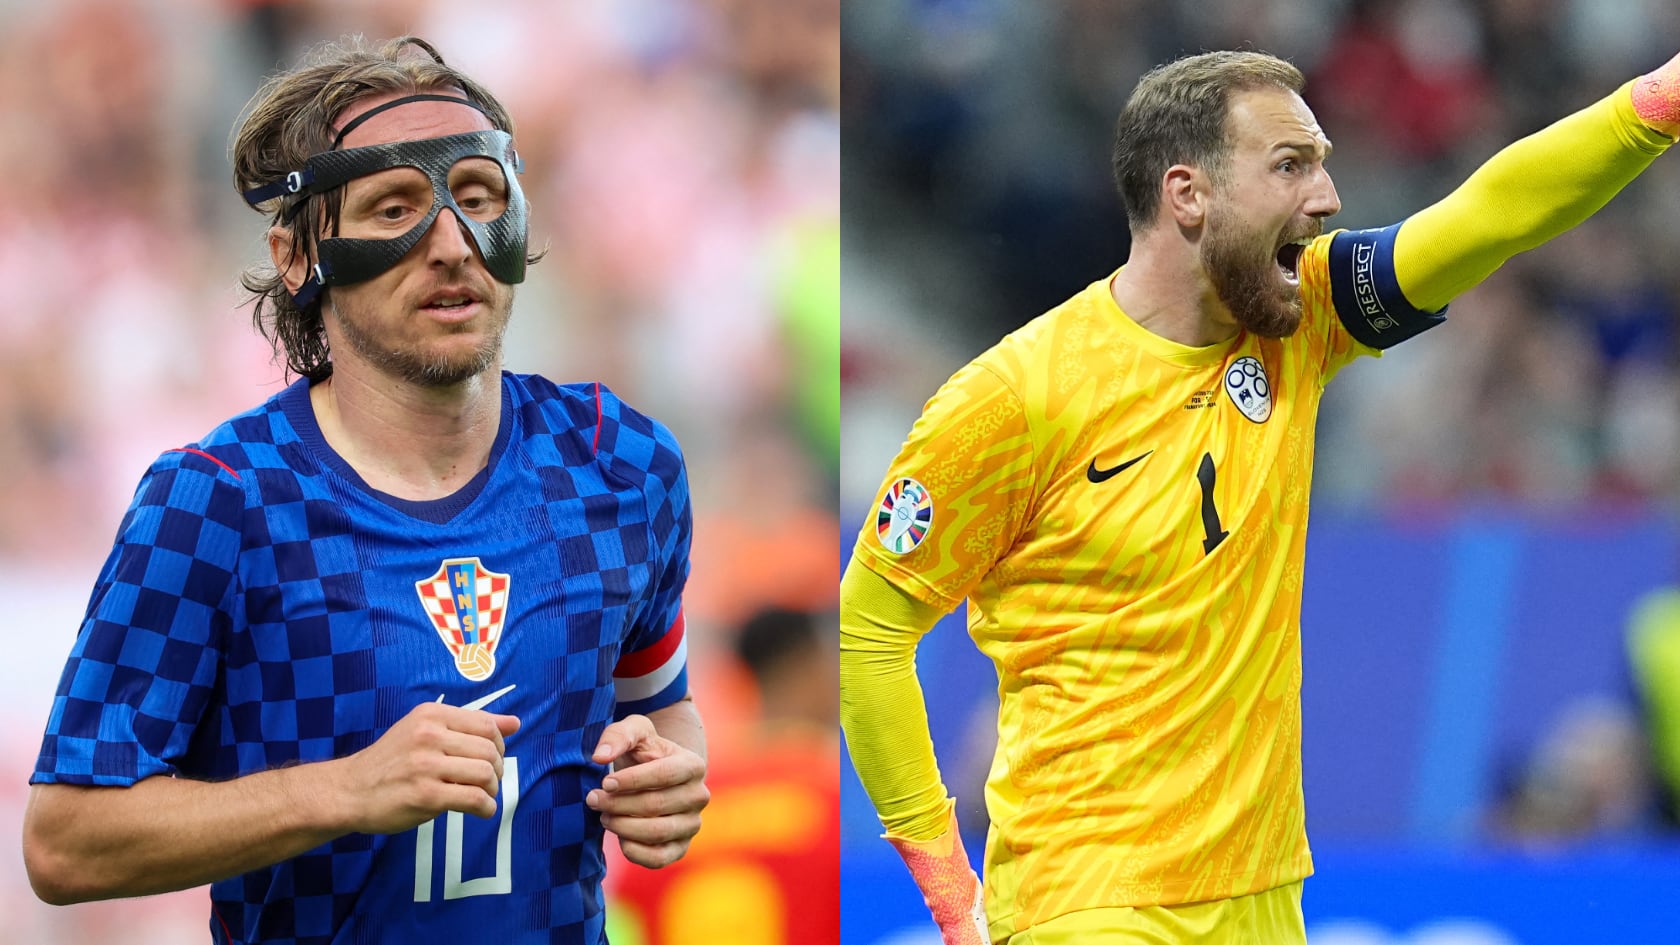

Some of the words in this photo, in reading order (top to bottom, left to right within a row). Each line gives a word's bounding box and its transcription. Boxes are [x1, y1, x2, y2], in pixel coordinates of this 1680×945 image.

[1357, 243, 1380, 315] RESPECT
[1196, 451, 1230, 556] 1
[454, 571, 475, 632] HNS
[413, 756, 520, 903] 10
